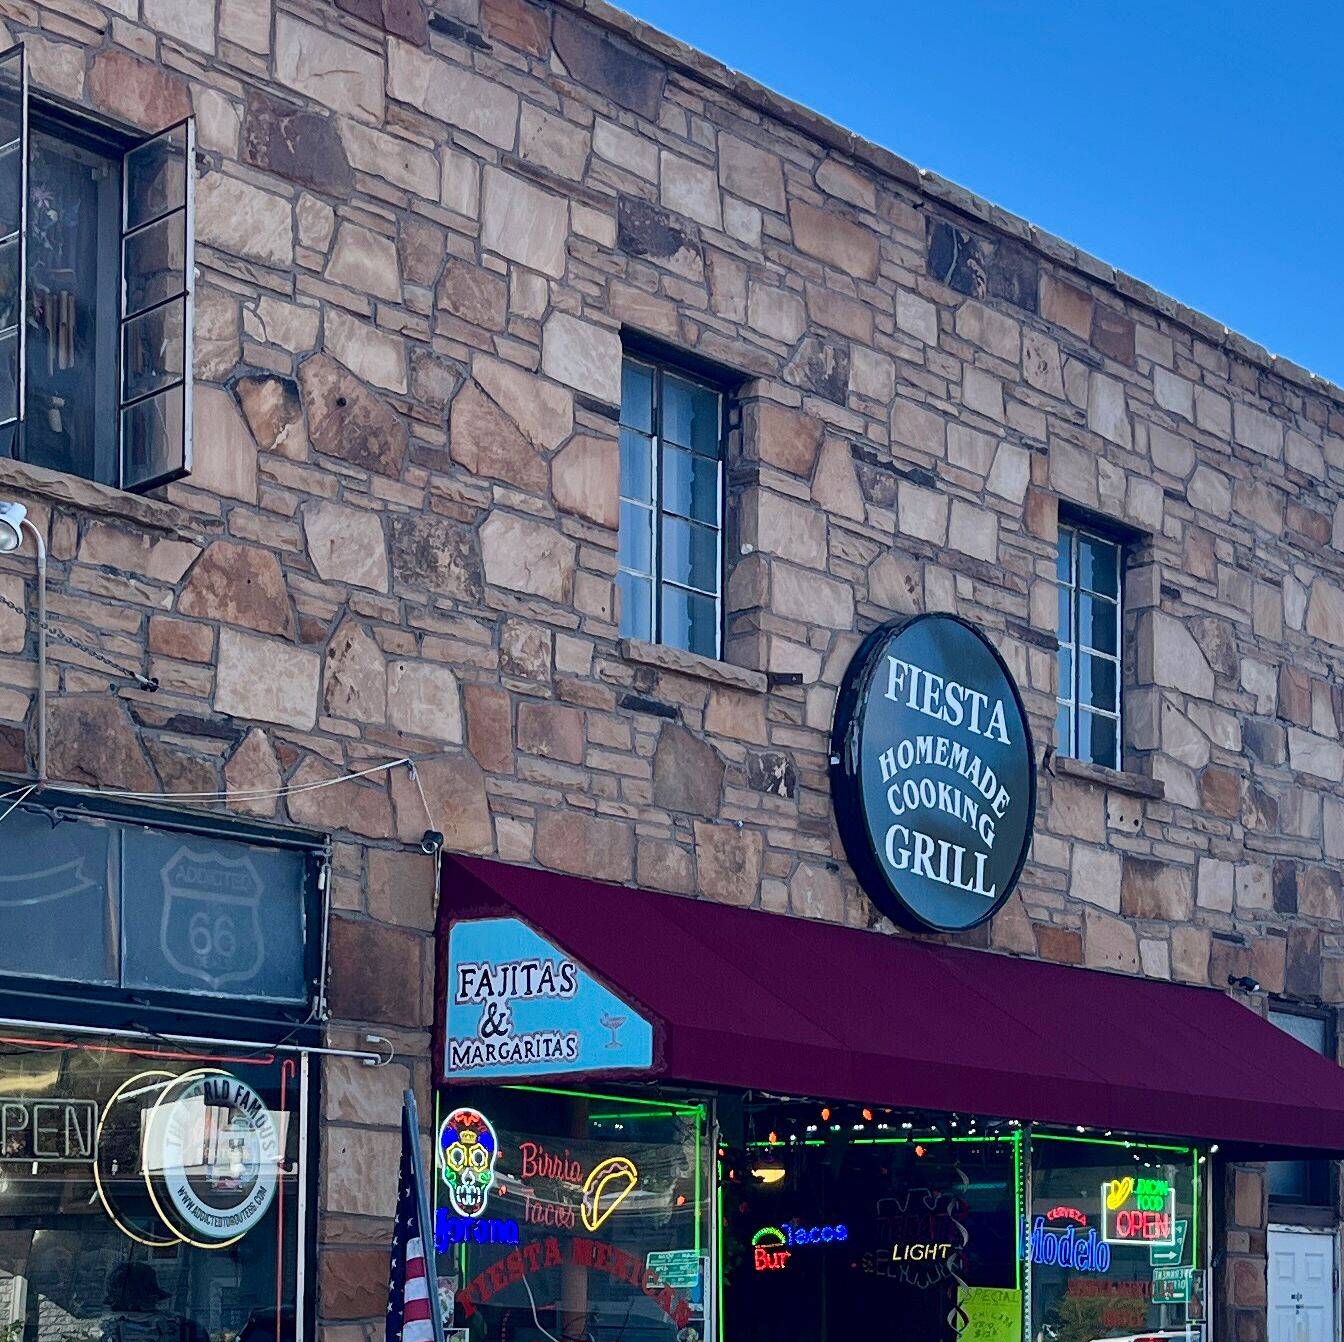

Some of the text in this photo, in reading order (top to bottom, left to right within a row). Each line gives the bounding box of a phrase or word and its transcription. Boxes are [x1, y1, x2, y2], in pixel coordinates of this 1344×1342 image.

[884, 655, 1011, 746] FIESTA
[878, 734, 1011, 819] HOMEMADE
[886, 778, 996, 850] COOKING
[885, 823, 996, 899] GRILL
[189, 911, 236, 958] 66
[459, 963, 576, 998] FAJITAS
[481, 1001, 509, 1039] &
[452, 1037, 576, 1066] MARGARITAS
[783, 1223, 848, 1247] Tacos
[1046, 1206, 1088, 1227] CERVEZA
[1116, 1210, 1170, 1239] OPEN
[892, 1243, 952, 1261] LIGHT
[457, 1237, 563, 1319] FIESTA
